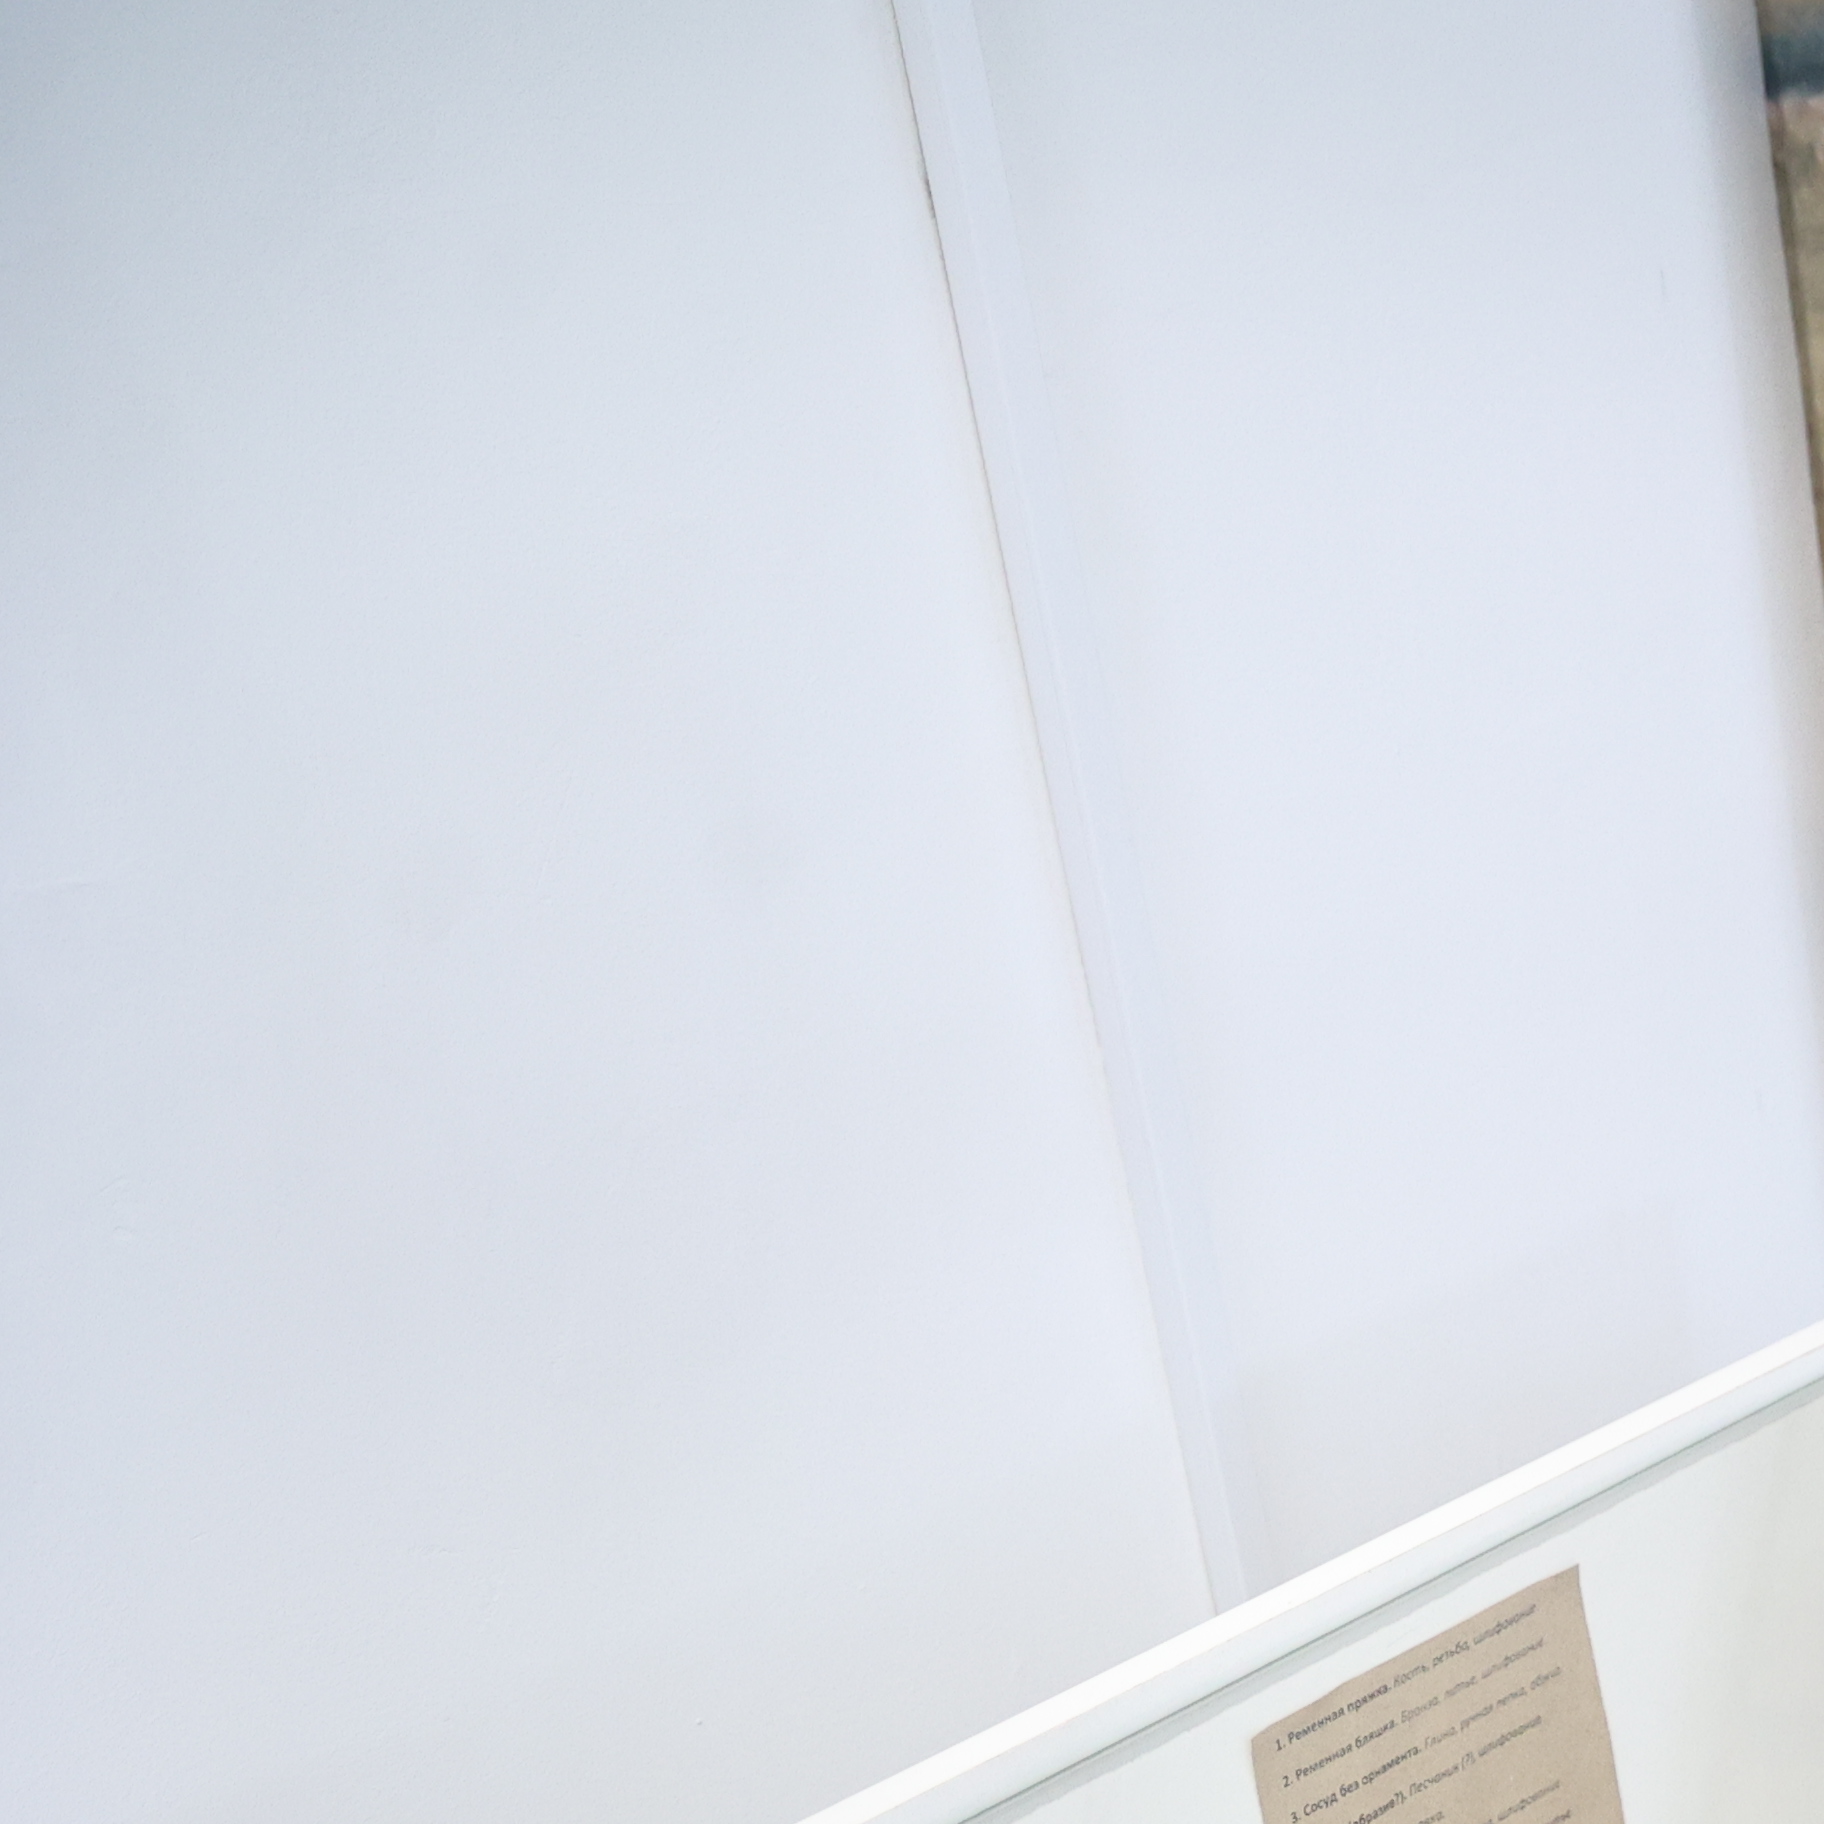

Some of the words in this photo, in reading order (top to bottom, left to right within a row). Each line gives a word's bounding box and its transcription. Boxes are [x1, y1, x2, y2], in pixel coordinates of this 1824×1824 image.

[1287, 1707, 1345, 1744] Ременная
[1295, 1743, 1353, 1781] Ременная
[1303, 1792, 1338, 1816] Сосуд
[1362, 1746, 1422, 1785] орнамента.
